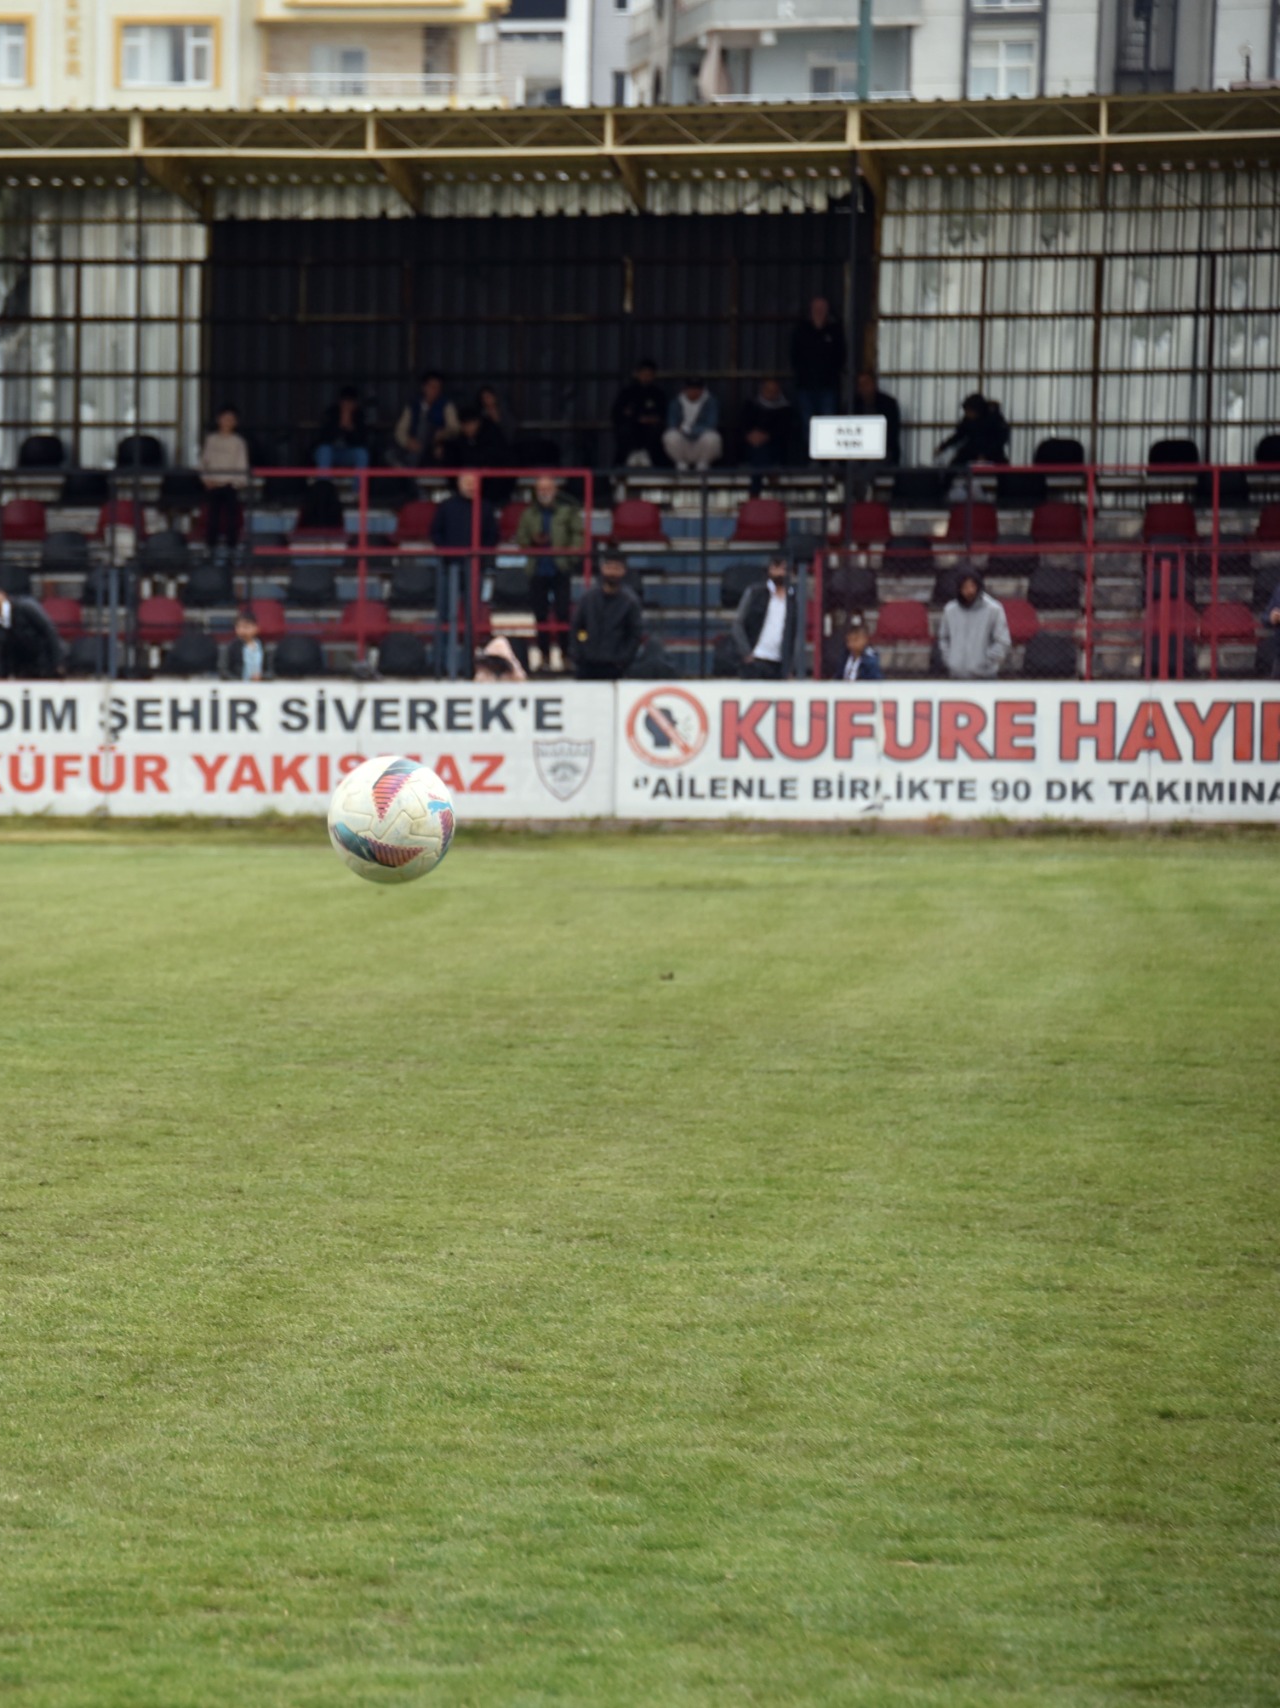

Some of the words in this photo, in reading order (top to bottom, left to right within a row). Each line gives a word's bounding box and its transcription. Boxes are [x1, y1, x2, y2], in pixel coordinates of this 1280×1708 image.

[280, 689, 564, 733] SİVEREK'E
[191, 753, 506, 793] YAKIAZ
[990, 779, 1032, 802] 90
[1045, 780, 1095, 803] DK
